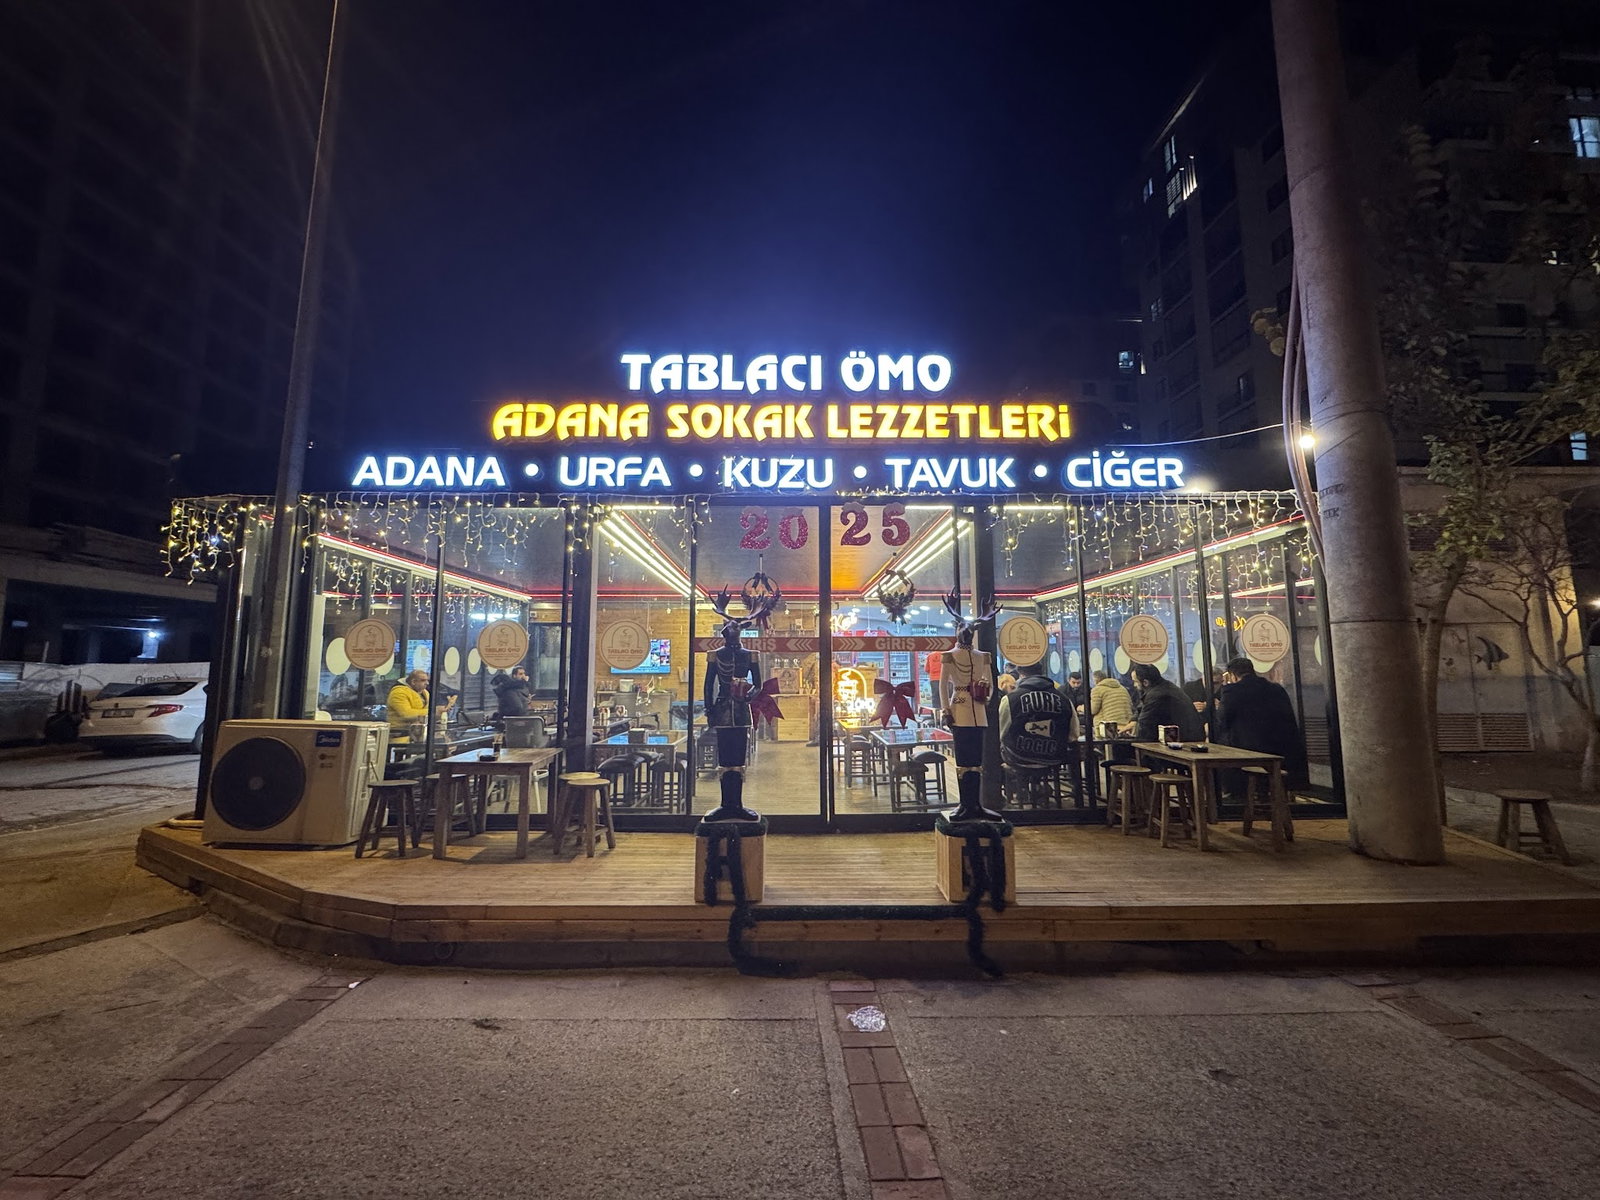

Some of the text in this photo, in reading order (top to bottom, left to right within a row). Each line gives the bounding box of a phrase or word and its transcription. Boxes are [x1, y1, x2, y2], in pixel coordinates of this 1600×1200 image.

[621, 351, 953, 395] TABLACI ÖMO
[492, 403, 650, 442] ADANA
[667, 403, 815, 442] SOKAK
[352, 450, 1186, 489] ADANA URFA KUZU TAVUK CİĞER
[1020, 691, 1062, 713] PURE
